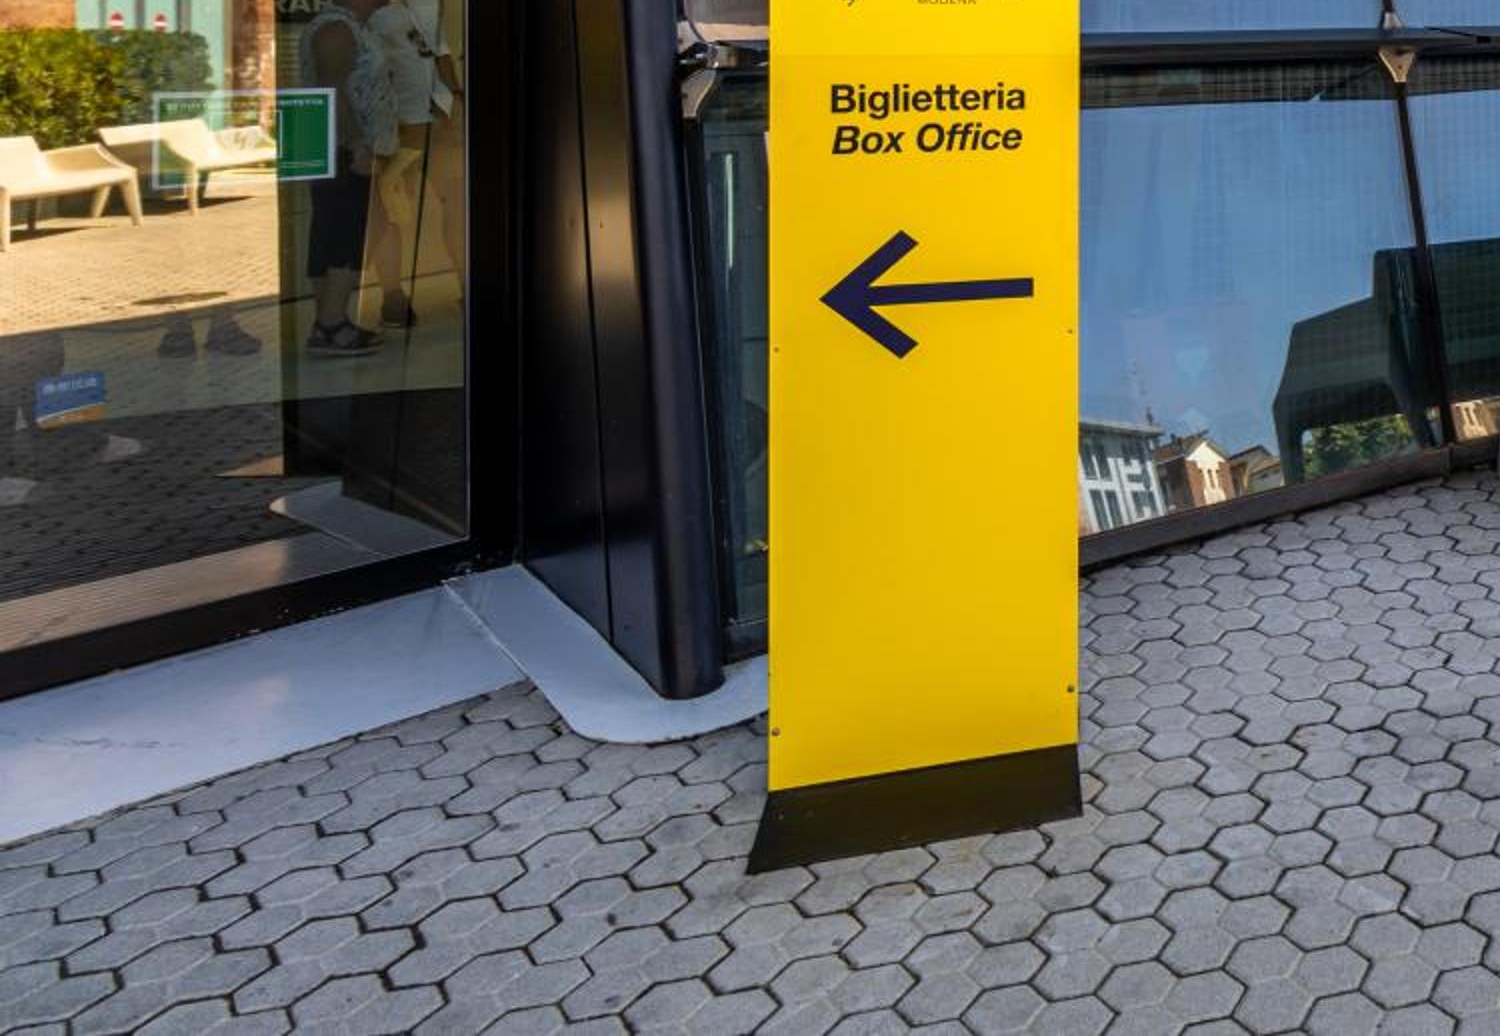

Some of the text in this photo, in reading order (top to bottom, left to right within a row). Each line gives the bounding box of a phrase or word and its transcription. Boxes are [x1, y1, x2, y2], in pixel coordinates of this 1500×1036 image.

[830, 82, 1026, 120] Biglietteria
[831, 122, 1024, 156] Box Office
